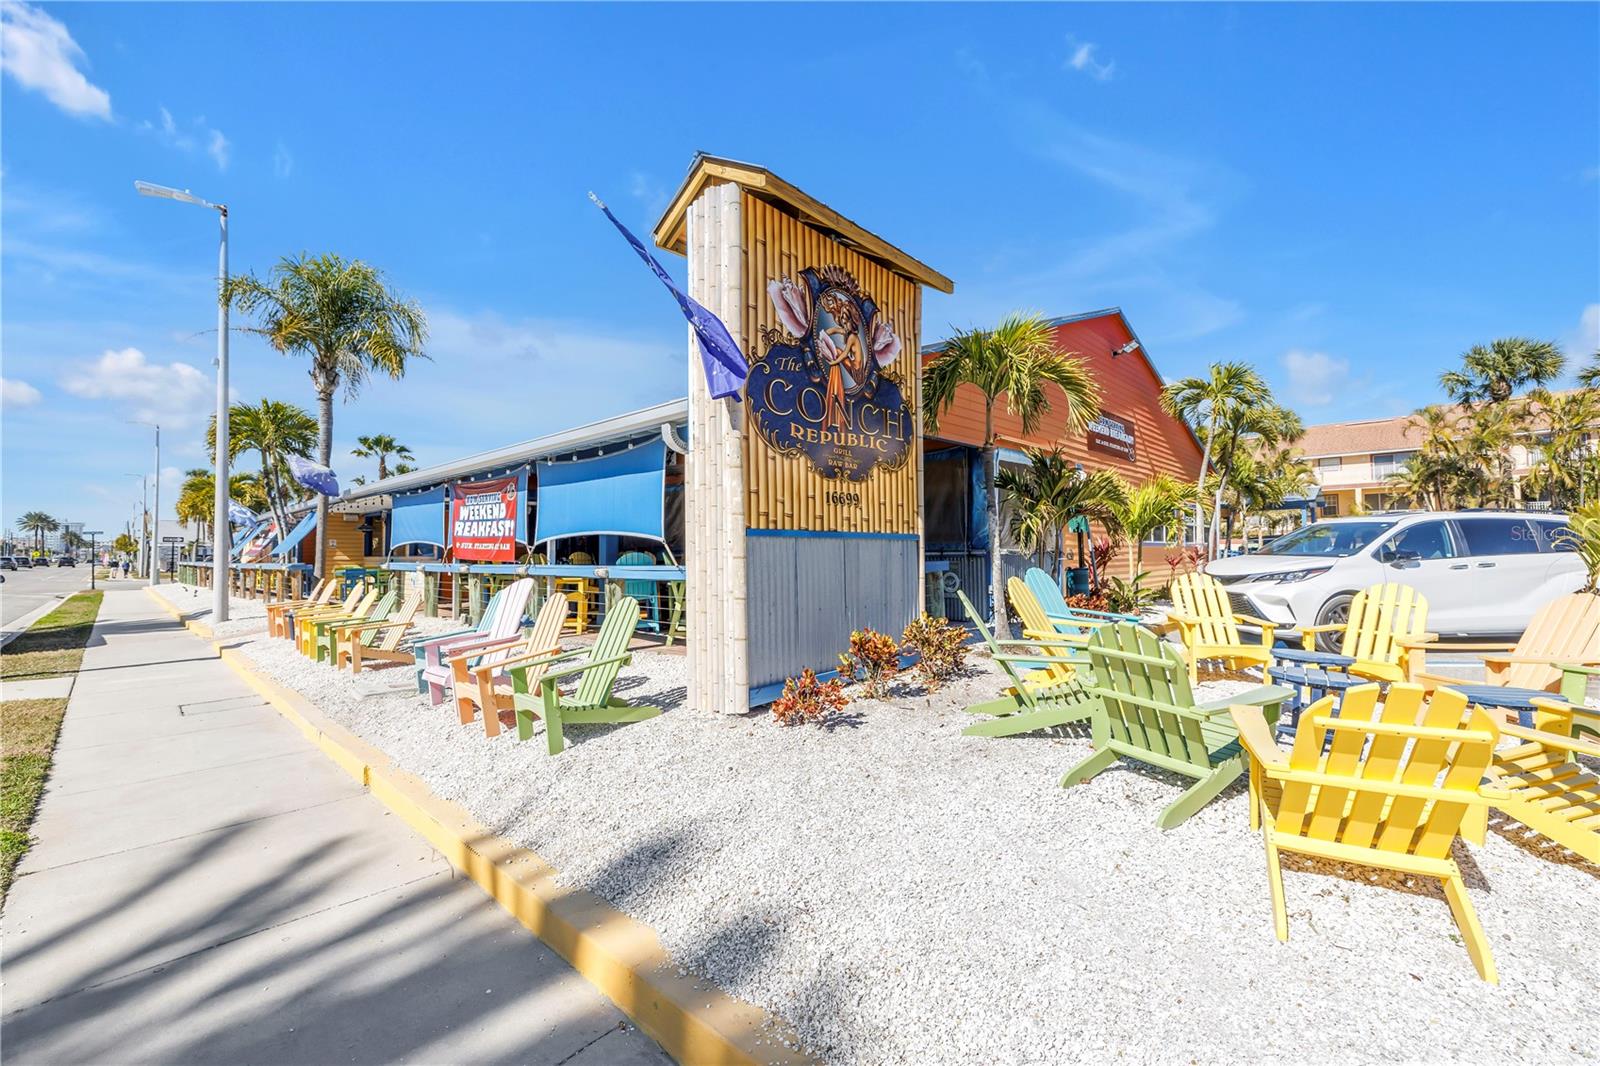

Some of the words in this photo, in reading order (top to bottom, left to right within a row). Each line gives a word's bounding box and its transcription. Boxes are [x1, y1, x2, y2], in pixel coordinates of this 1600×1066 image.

[775, 356, 801, 372] The
[764, 379, 904, 441] CONCH
[790, 422, 888, 452] REPUBLIC
[833, 447, 853, 456] GRILL
[844, 462, 858, 470] BAR
[825, 490, 860, 506] 16699
[459, 503, 507, 520] WEEKEND
[454, 520, 514, 537] REAKFAST!
